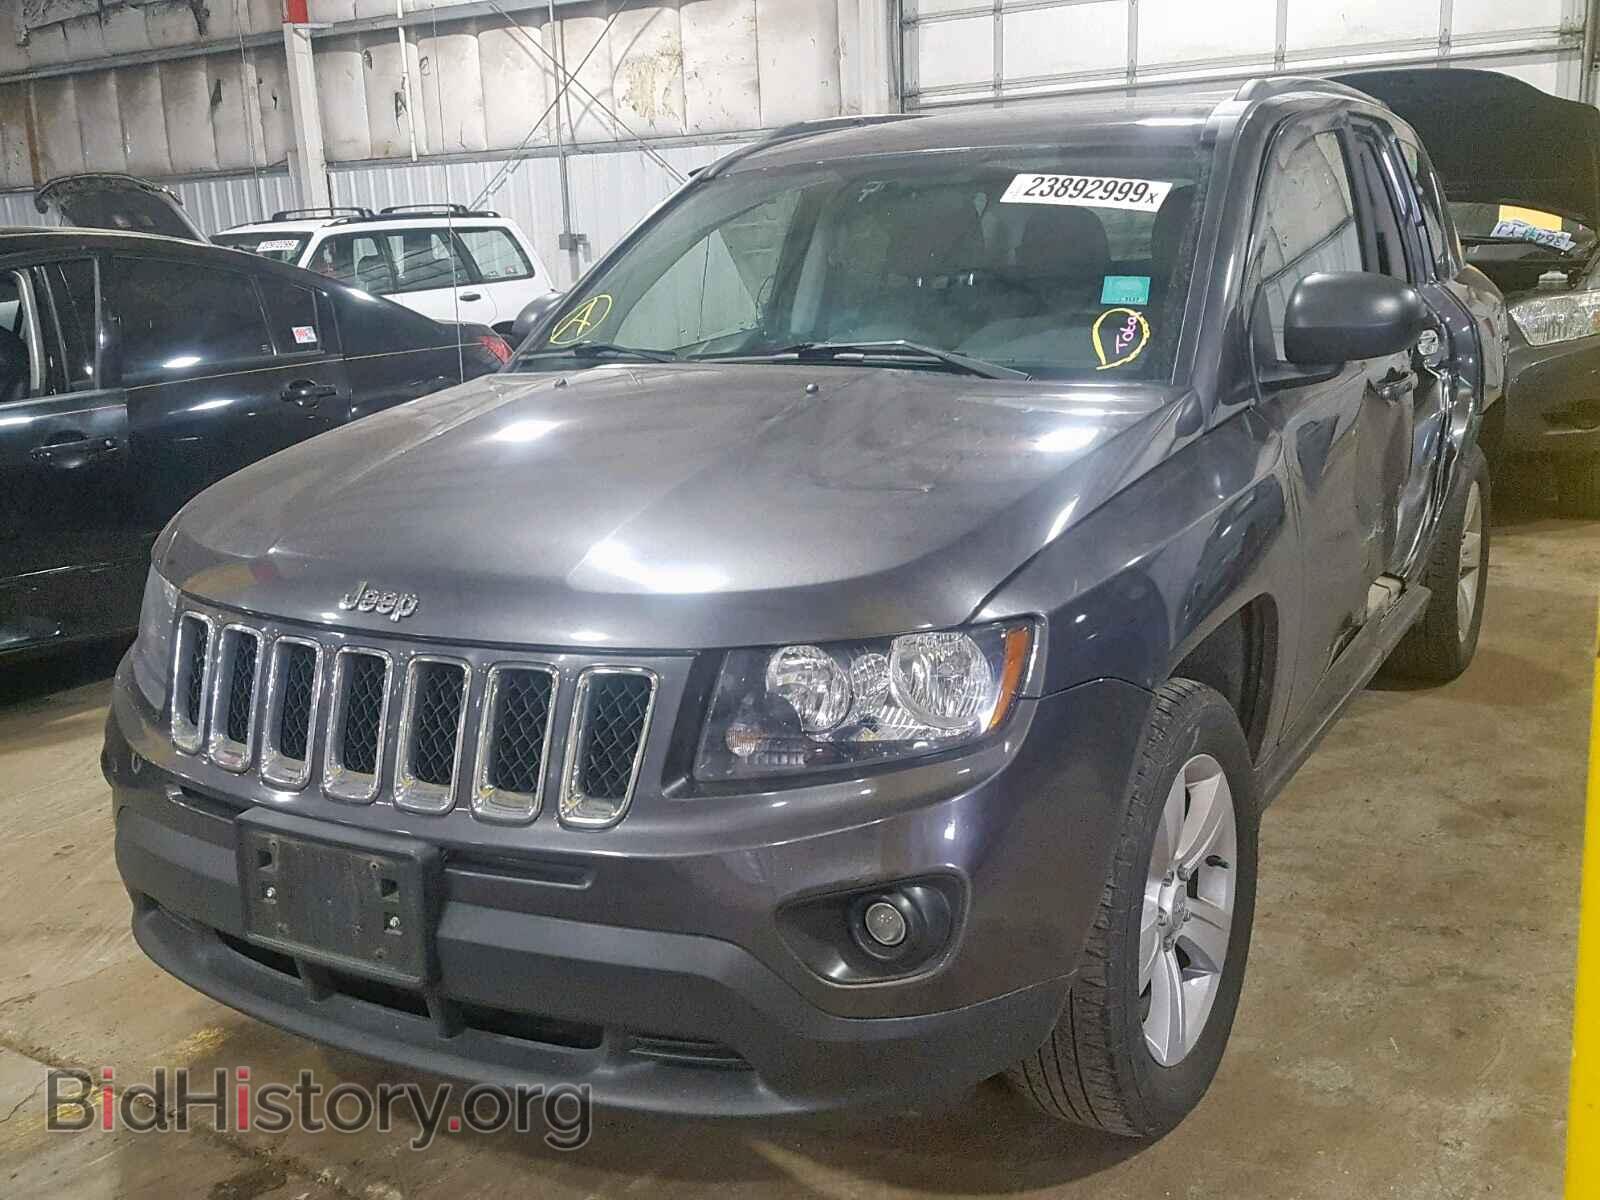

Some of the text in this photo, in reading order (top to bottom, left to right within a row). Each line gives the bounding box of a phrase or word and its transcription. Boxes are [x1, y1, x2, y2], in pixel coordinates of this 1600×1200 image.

[1023, 176, 1159, 204] 23892999x
[550, 297, 591, 341] A
[338, 580, 419, 621] Jeep
